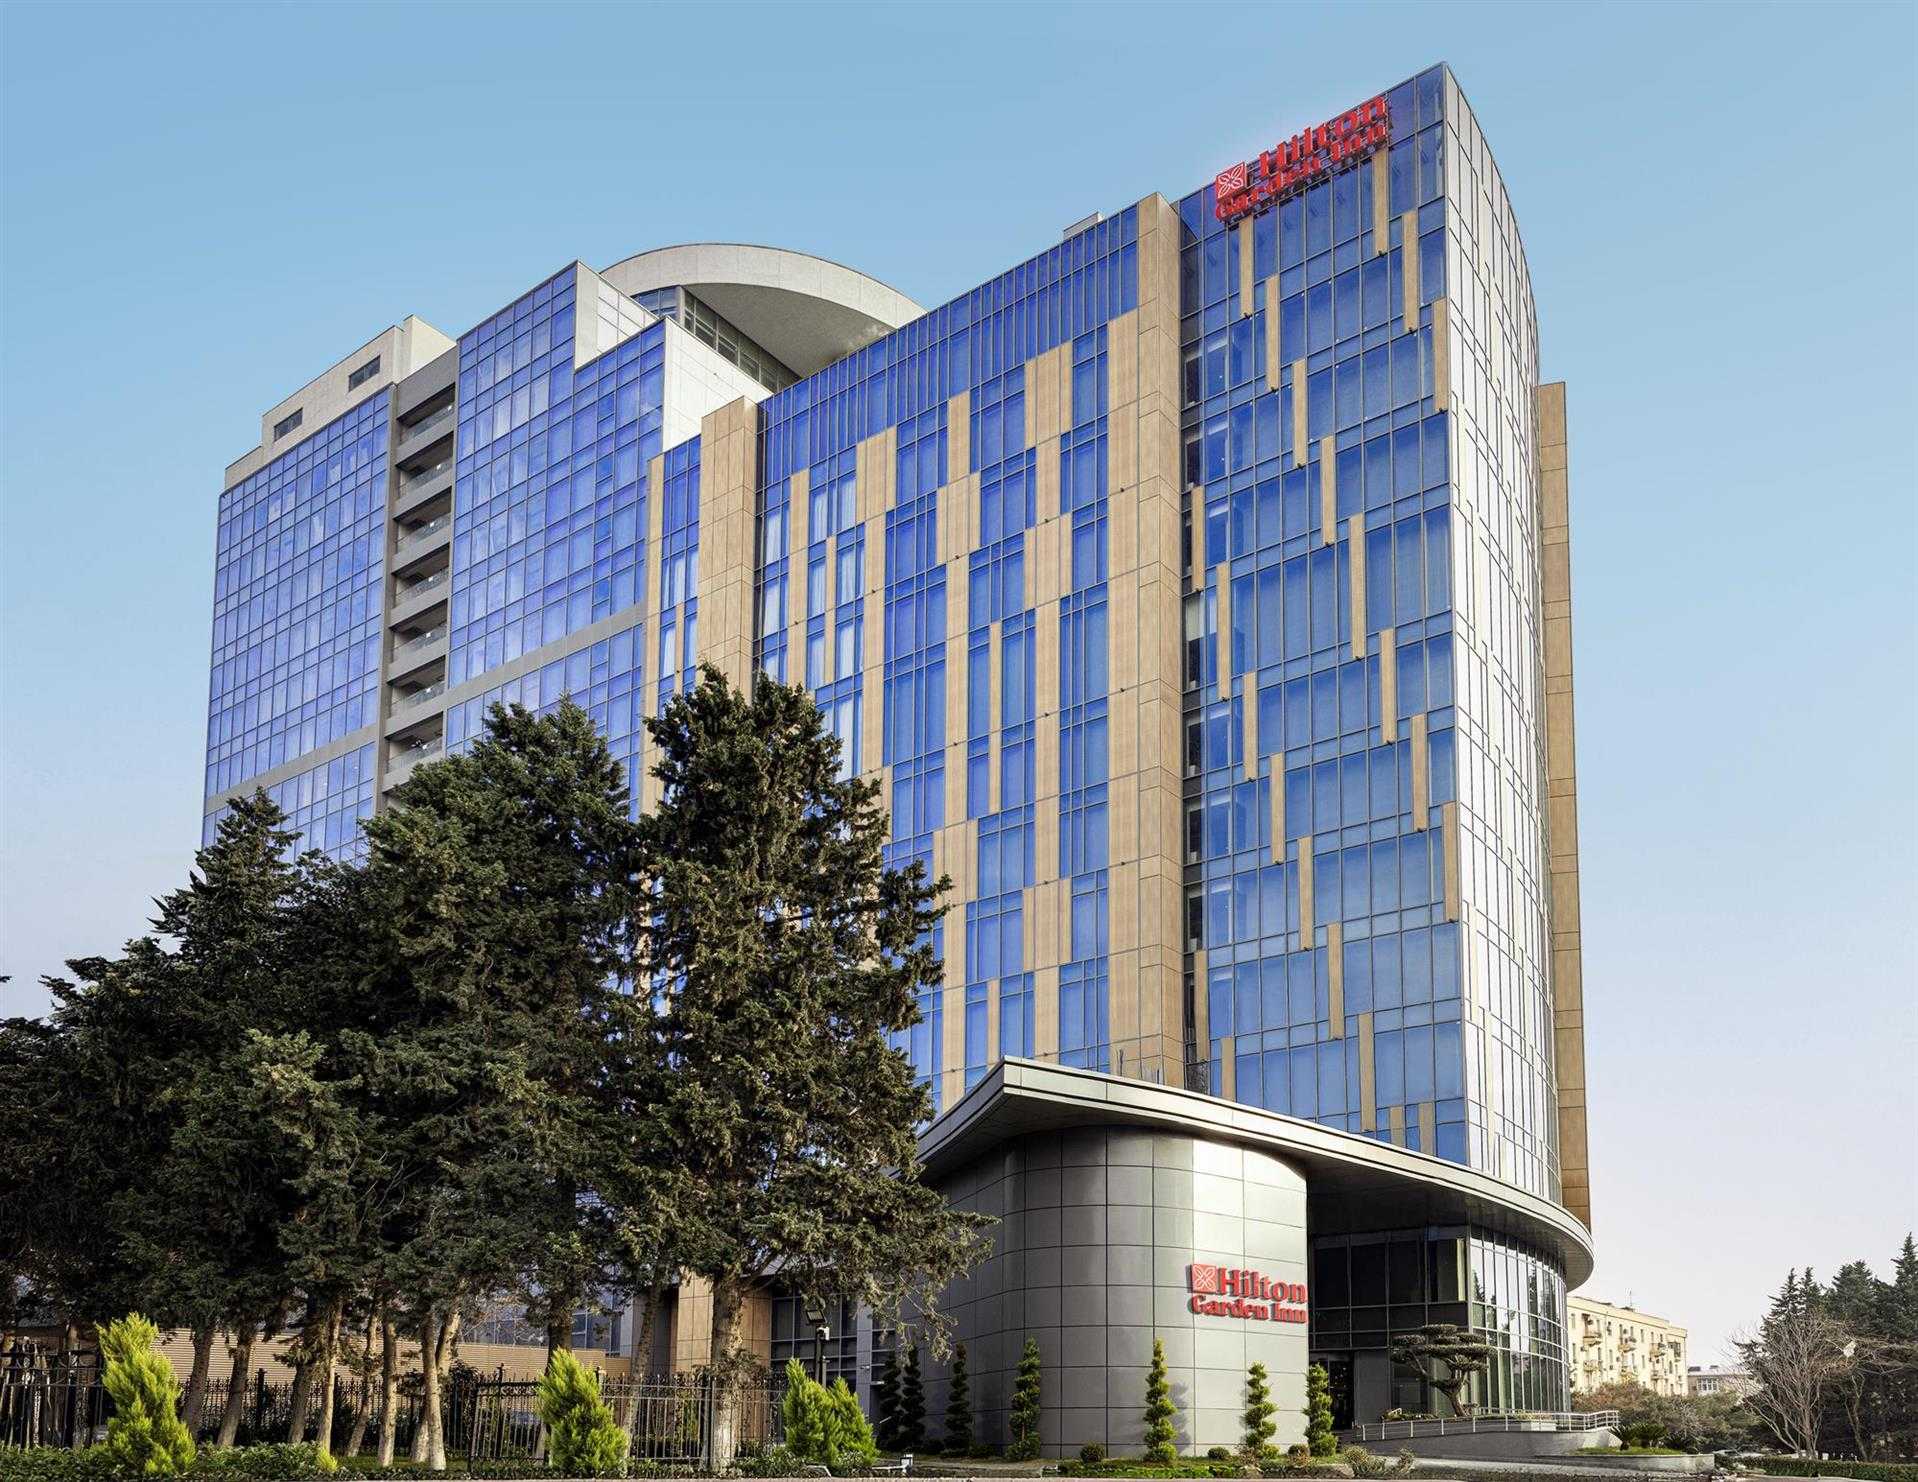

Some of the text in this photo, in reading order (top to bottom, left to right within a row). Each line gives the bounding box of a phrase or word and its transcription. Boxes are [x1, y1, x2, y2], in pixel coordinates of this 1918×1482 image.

[1259, 96, 1386, 177] Hilton
[1217, 1267, 1307, 1304] Hilton
[1187, 1295, 1307, 1323] Garden Inn
